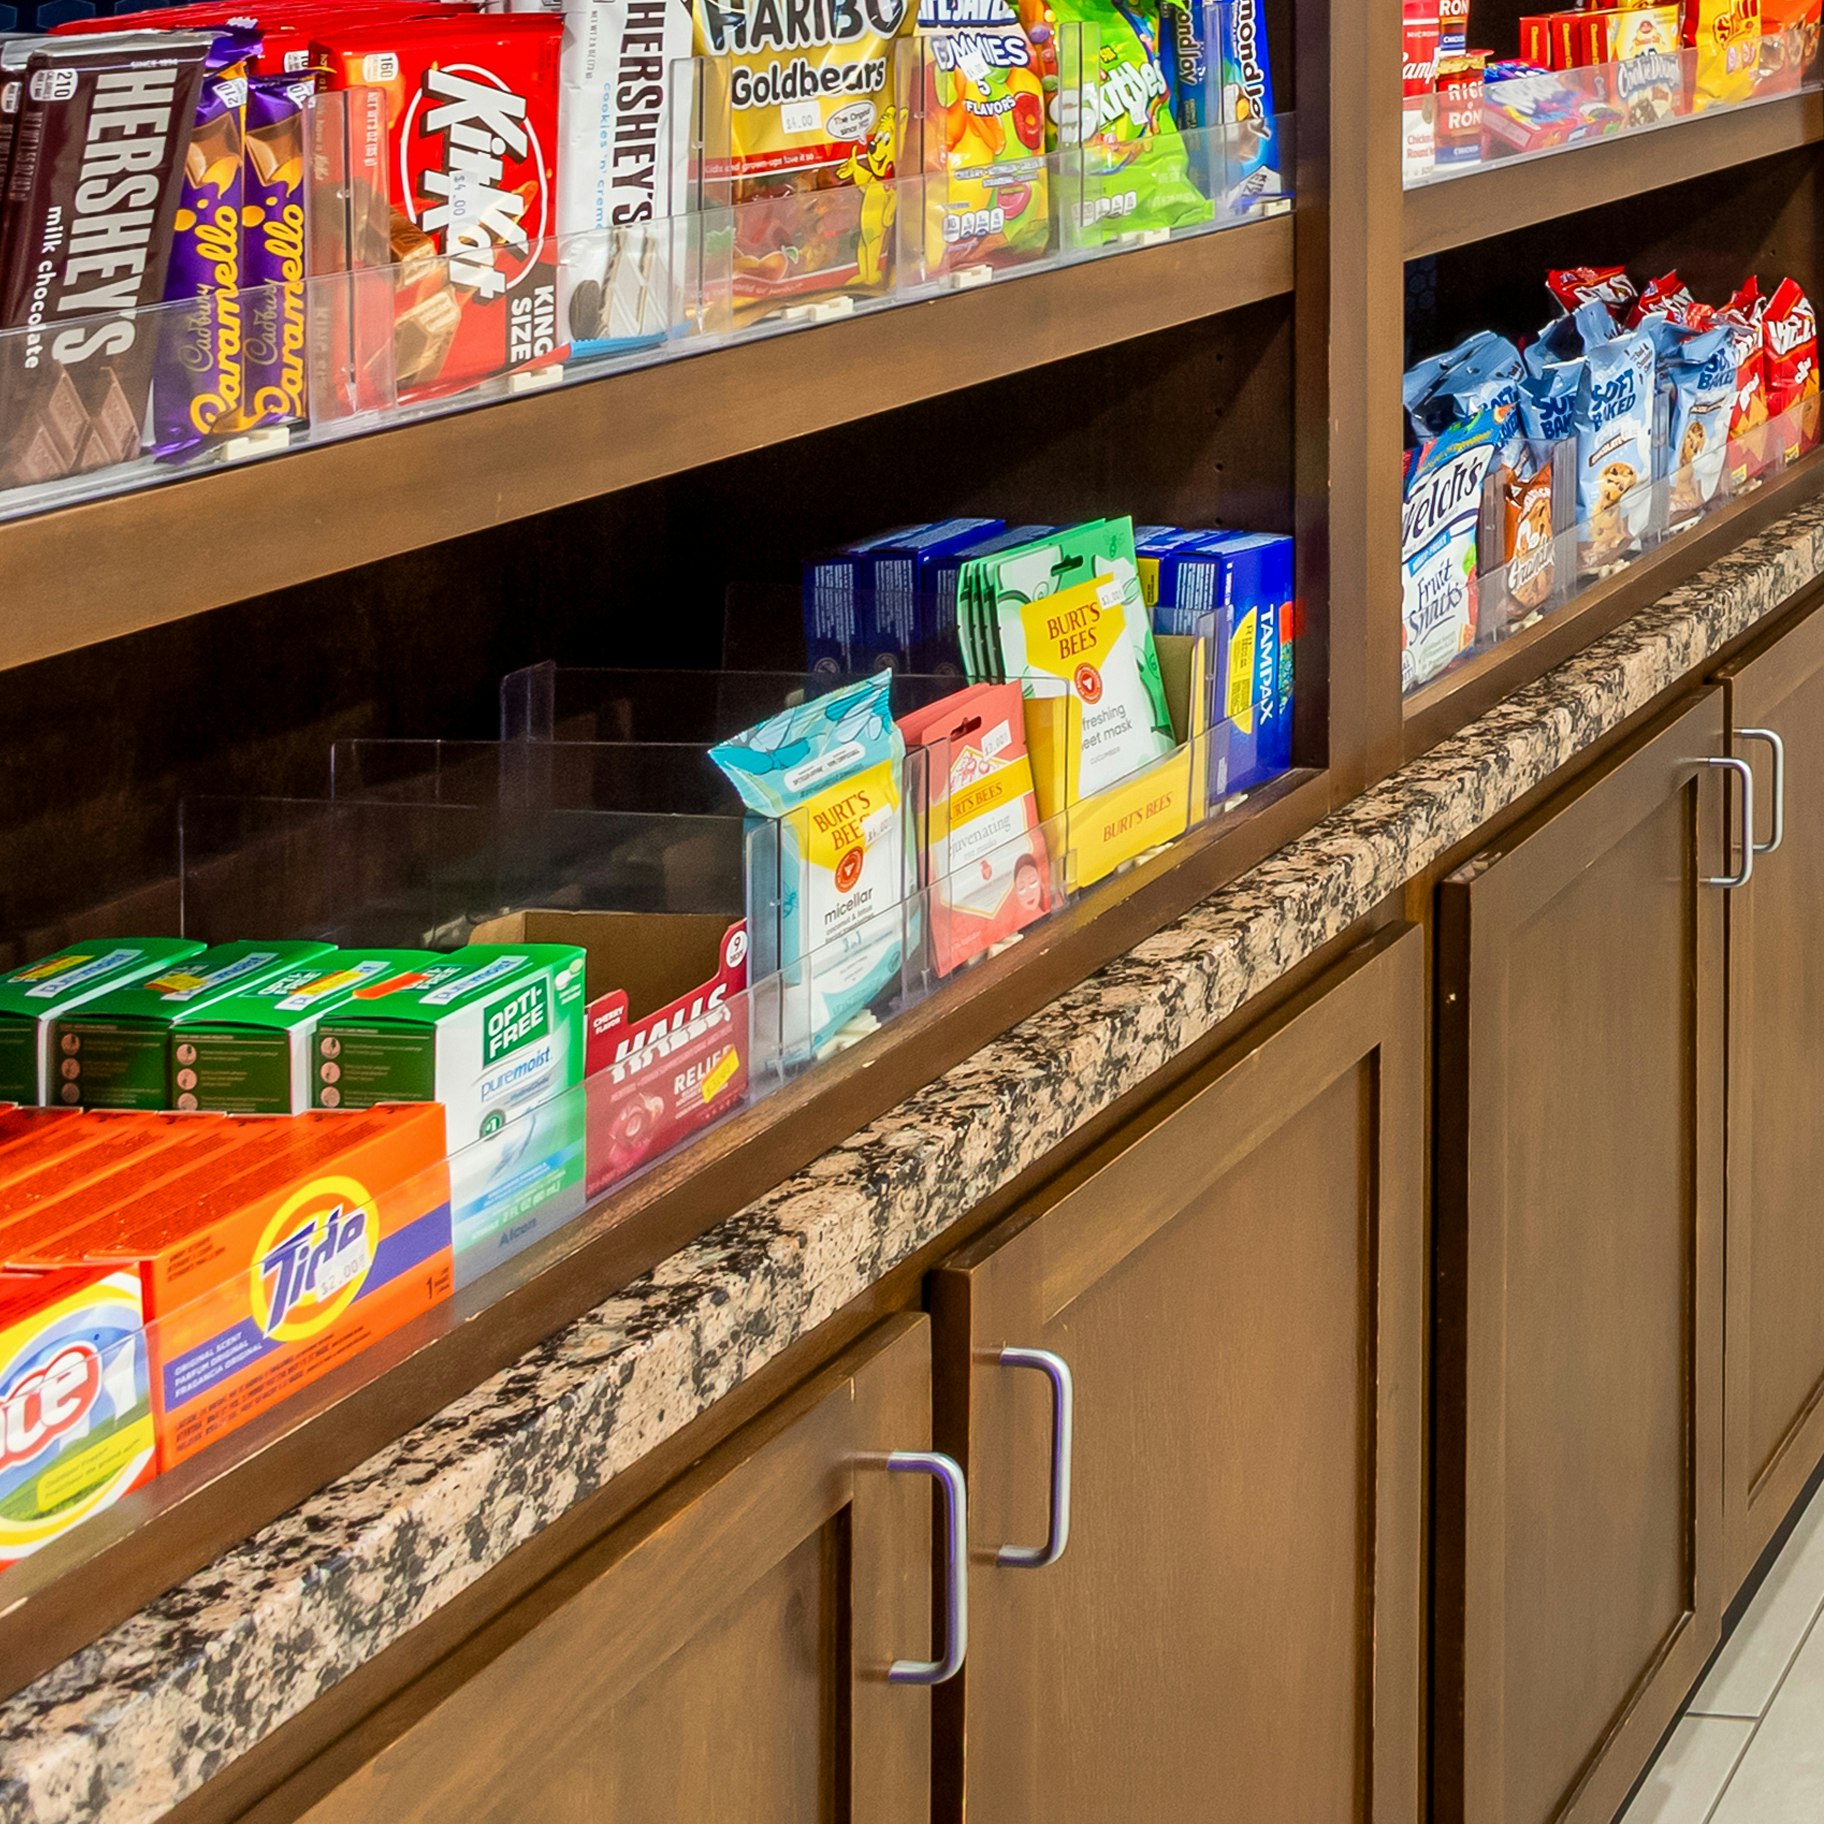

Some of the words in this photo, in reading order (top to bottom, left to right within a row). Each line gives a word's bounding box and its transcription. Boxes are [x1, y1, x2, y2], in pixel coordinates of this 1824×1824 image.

[53, 71, 73, 98] 210
[379, 56, 394, 78] 160
[732, 59, 885, 106] Goldbears
[976, 77, 991, 95] 5
[600, 82, 611, 149] cookies
[612, 1, 667, 226] HERSHEY'S
[965, 95, 1016, 115] FLAVORS
[742, 157, 783, 171] grown-ups
[784, 154, 798, 165] love
[453, 175, 465, 216] $4.00
[42, 205, 62, 254] milk
[25, 260, 57, 369] chocolate
[177, 283, 215, 373] Cadbury
[189, 205, 238, 435] Caramello
[254, 204, 304, 430] Caramello
[510, 298, 534, 364] SIZE
[533, 284, 555, 357] KING
[1591, 368, 1634, 411] SOFT
[1592, 393, 1636, 432] BAKED
[1417, 558, 1453, 610] Fruit
[1047, 602, 1100, 640] BURT'S
[1409, 582, 1462, 646] Snacks
[1059, 626, 1097, 660] BEES
[1260, 603, 1274, 725] TAMPAX
[1081, 704, 1126, 731] freshing
[1103, 718, 1132, 742] mask
[1090, 747, 1121, 765] CUCUMBER
[813, 790, 871, 833] BURT'S
[976, 782, 1003, 805] BEES
[832, 814, 870, 851] BEE
[1103, 807, 1143, 843] BURT'S
[1145, 792, 1173, 817] BEES
[824, 887, 874, 925] micellar
[733, 936, 741, 951] 9
[488, 983, 542, 1036] OPTI-
[593, 1005, 624, 1027] CHERRY
[489, 1007, 544, 1059] FREE
[611, 983, 732, 1084] HALLS
[481, 1046, 551, 1103] puremoist
[262, 1204, 366, 1339] Tide
[426, 1277, 433, 1299] 1
[216, 1332, 242, 1353] SCENT
